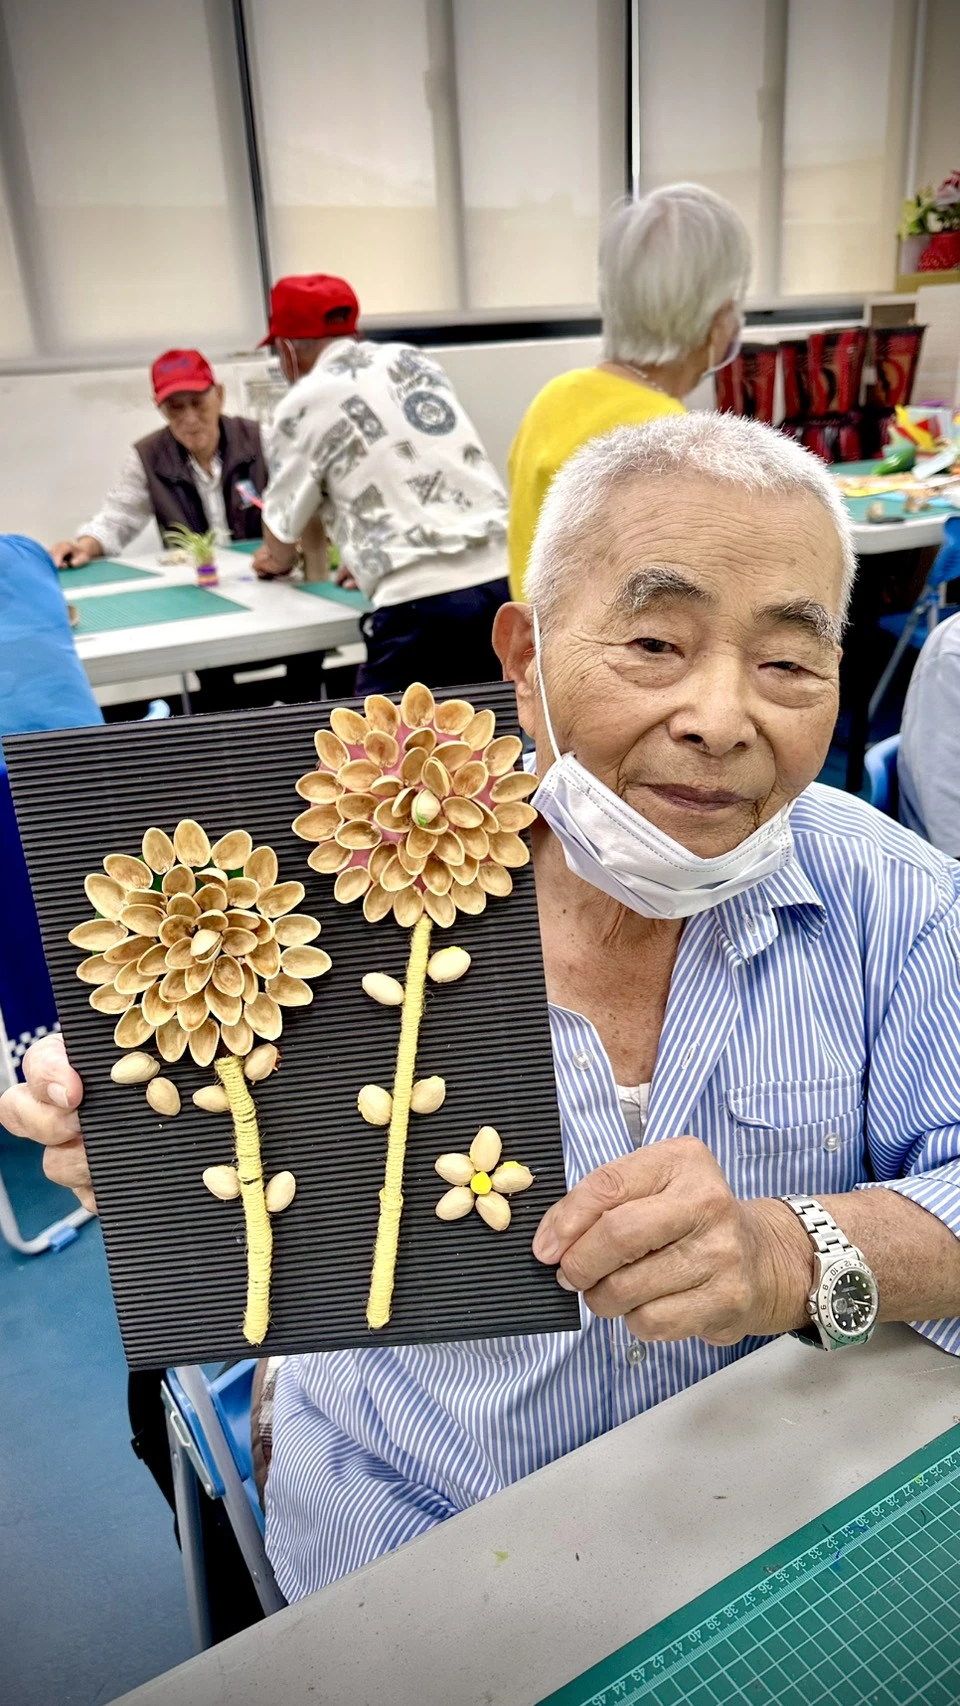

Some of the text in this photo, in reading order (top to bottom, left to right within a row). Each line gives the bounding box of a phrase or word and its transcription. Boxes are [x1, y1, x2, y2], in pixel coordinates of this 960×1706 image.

[830, 1268, 838, 1276] 10
[592, 1455, 956, 1706] 24 25 26 27 28 29 30 31 32 33 34 35 36 37 38 39 40 41 42 43 44 45
